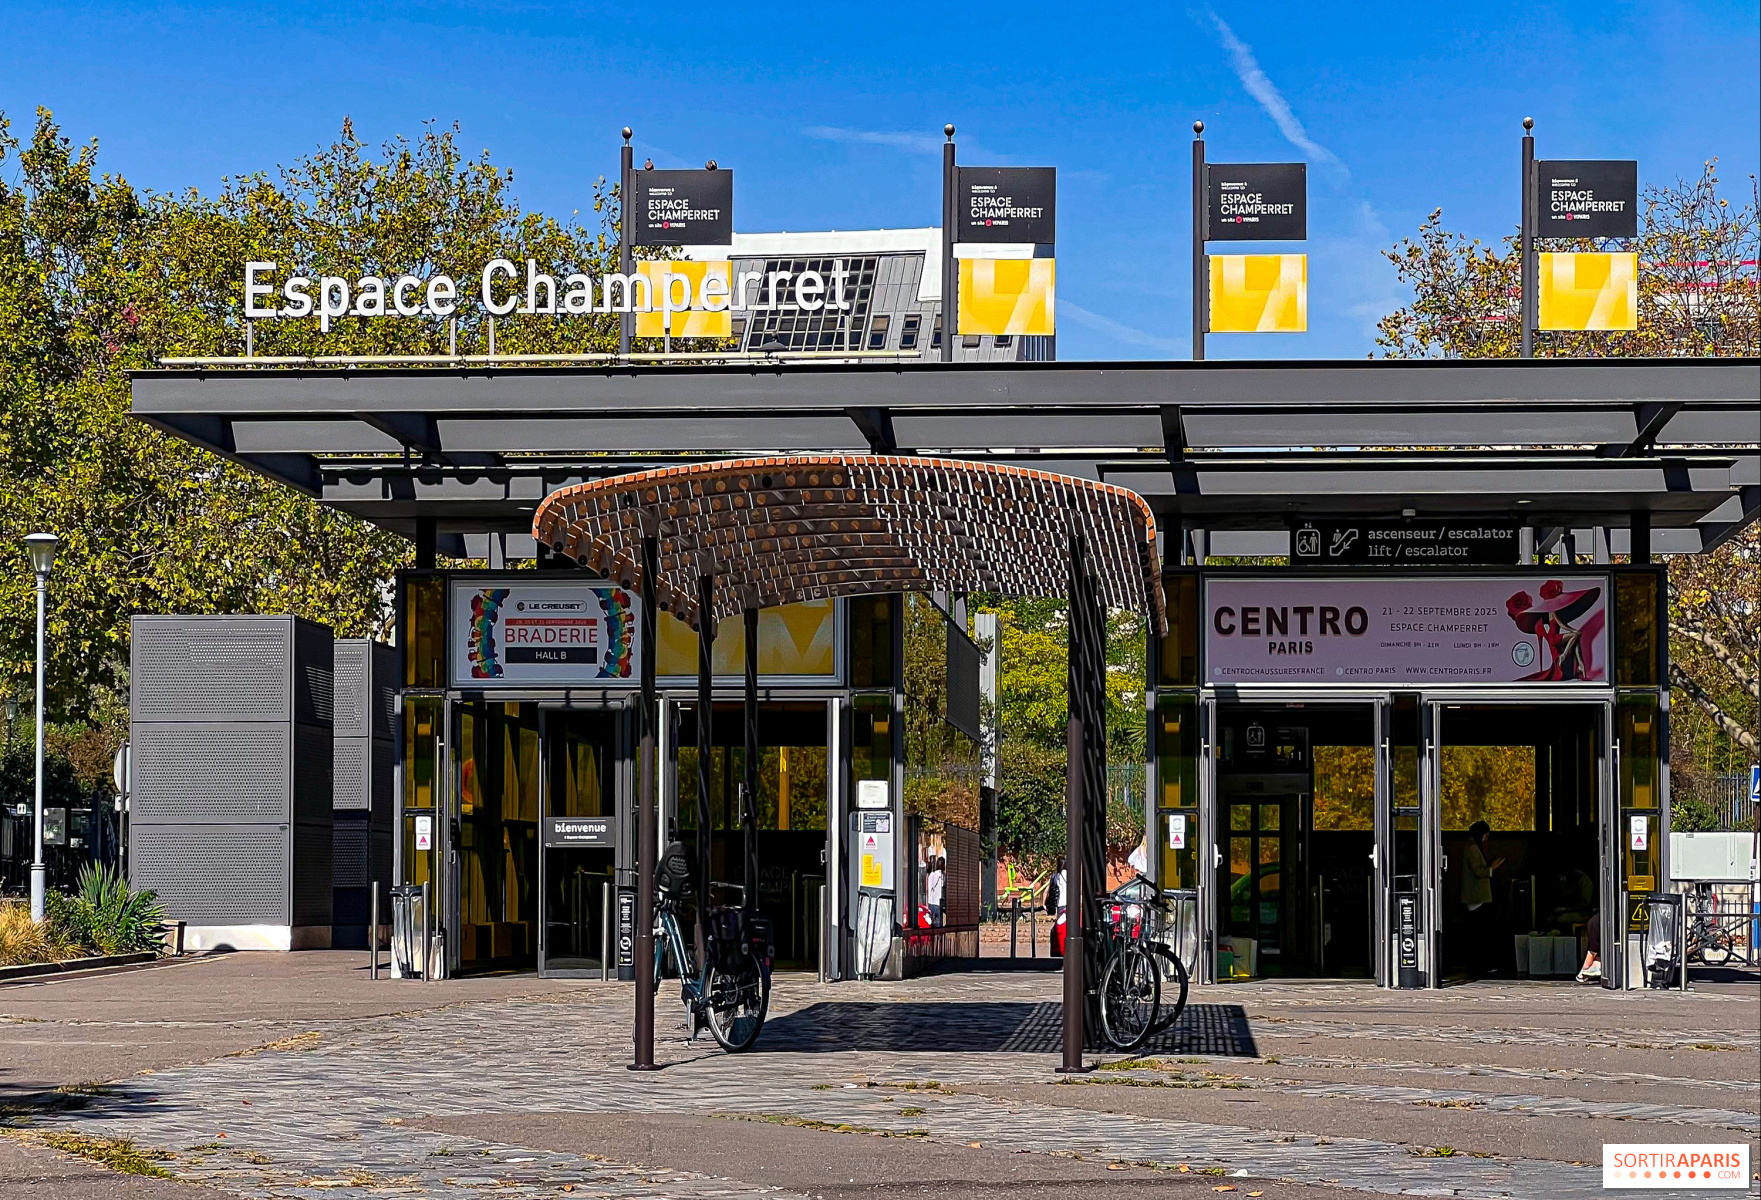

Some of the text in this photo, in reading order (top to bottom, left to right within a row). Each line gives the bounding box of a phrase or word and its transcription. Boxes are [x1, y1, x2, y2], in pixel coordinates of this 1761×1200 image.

[1220, 193, 1262, 204] ESPACE
[1551, 190, 1593, 201] ESPACE
[648, 199, 689, 210] ESPACE
[971, 197, 1012, 207] ESPACE
[1551, 201, 1626, 212] CHAMPERRET
[648, 209, 720, 220] CHAMPERRET
[970, 207, 1043, 218] CHAMPERRET
[1220, 204, 1294, 215] CHAMPERRET
[245, 258, 851, 333] Espace Champerret
[1367, 528, 1437, 540] ascenseur
[1448, 527, 1514, 540] escalator
[1368, 545, 1393, 557] lift
[1404, 545, 1469, 557] escalator
[1381, 607, 1394, 616] 21
[1403, 606, 1415, 615] 22
[1417, 607, 1471, 616] SEPTEMBRE
[1474, 607, 1498, 616] 2025
[1213, 605, 1369, 636] CENTRO
[1390, 623, 1489, 633] ESPACE CHAMPERRET
[504, 628, 598, 643] BRADERIE
[1268, 640, 1314, 655] PARIS
[535, 651, 567, 660] HALL B
[1222, 667, 1325, 675] CENTROCHAUSSURESFRANCE
[1344, 667, 1374, 675] CENTRO
[1405, 666, 1493, 675] WWW.CENTROPARIS.FR
[554, 822, 607, 833] bienvenue
